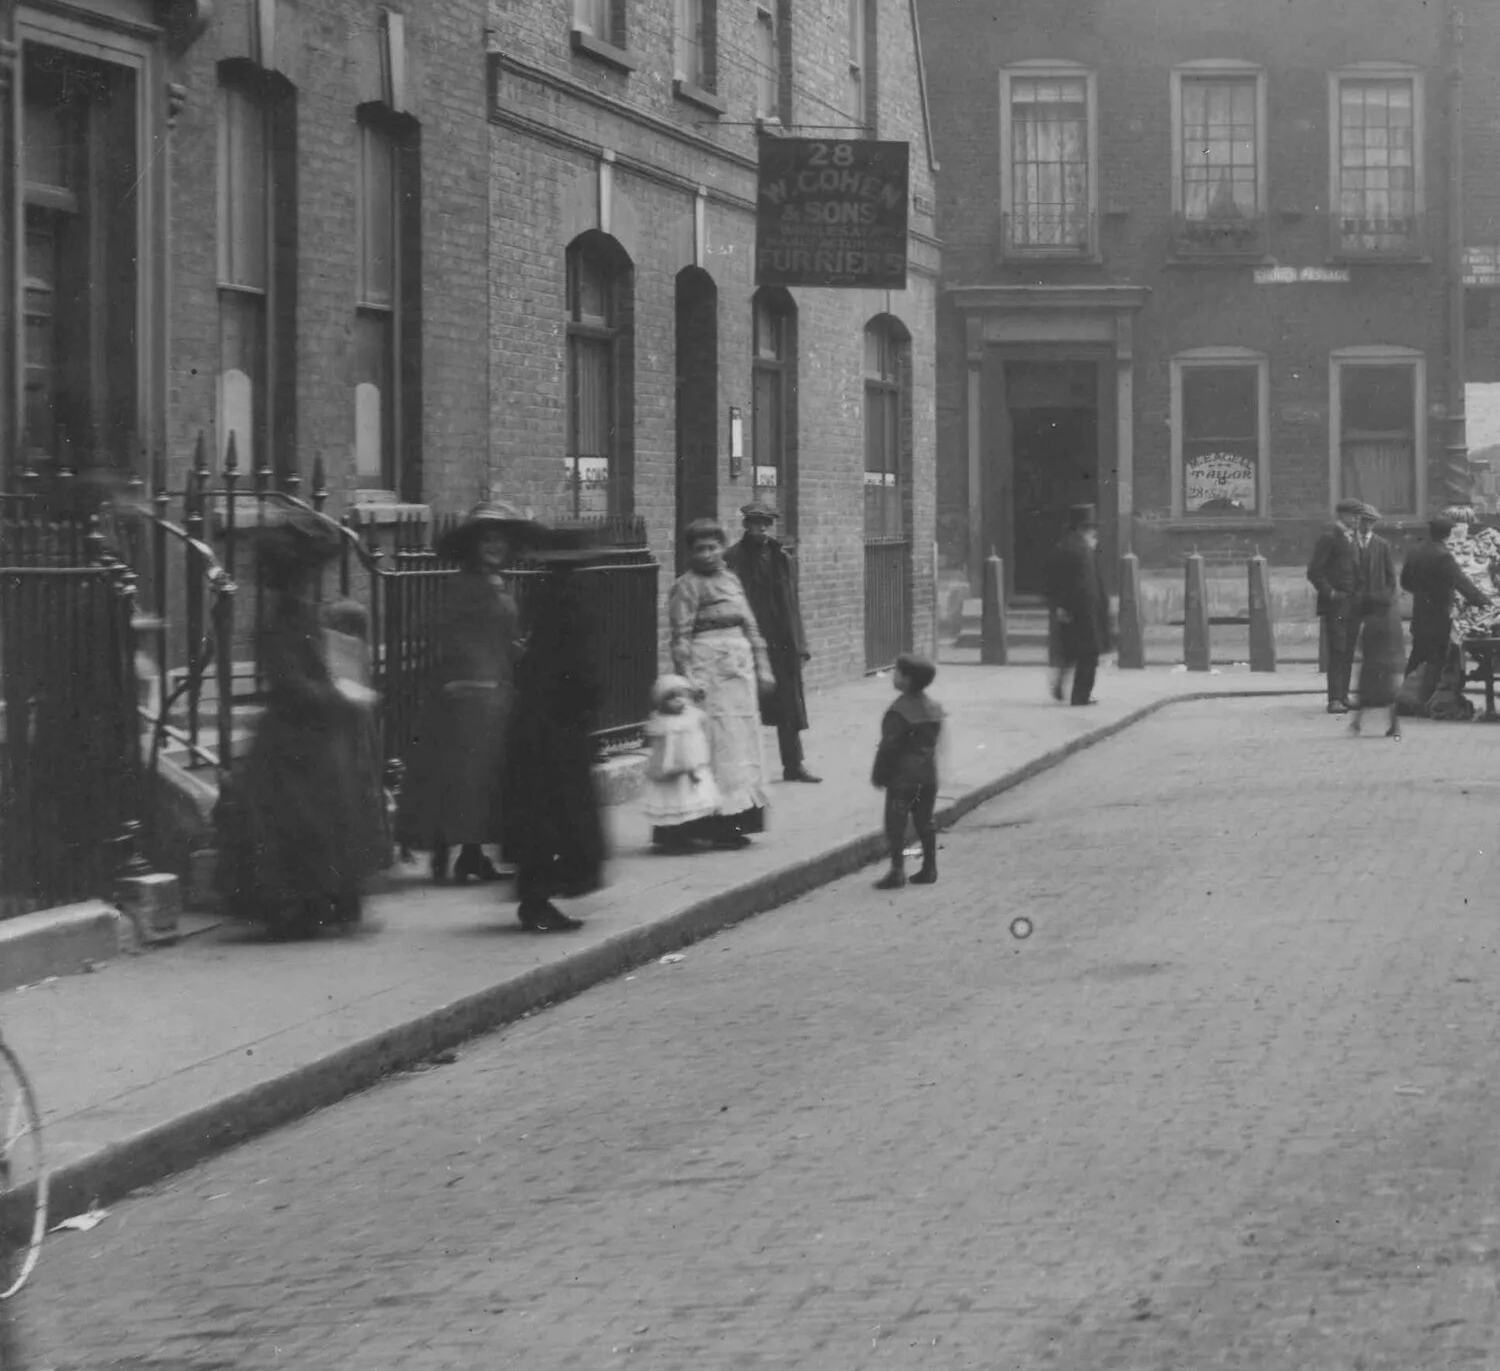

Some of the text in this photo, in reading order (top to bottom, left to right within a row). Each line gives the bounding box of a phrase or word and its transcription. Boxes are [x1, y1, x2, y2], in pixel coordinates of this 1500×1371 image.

[808, 142, 854, 167] 28
[797, 169, 903, 210] COHEN
[804, 201, 878, 225] SONS
[759, 248, 905, 275] FURRIERS
[1190, 470, 1252, 480] TAILOR
